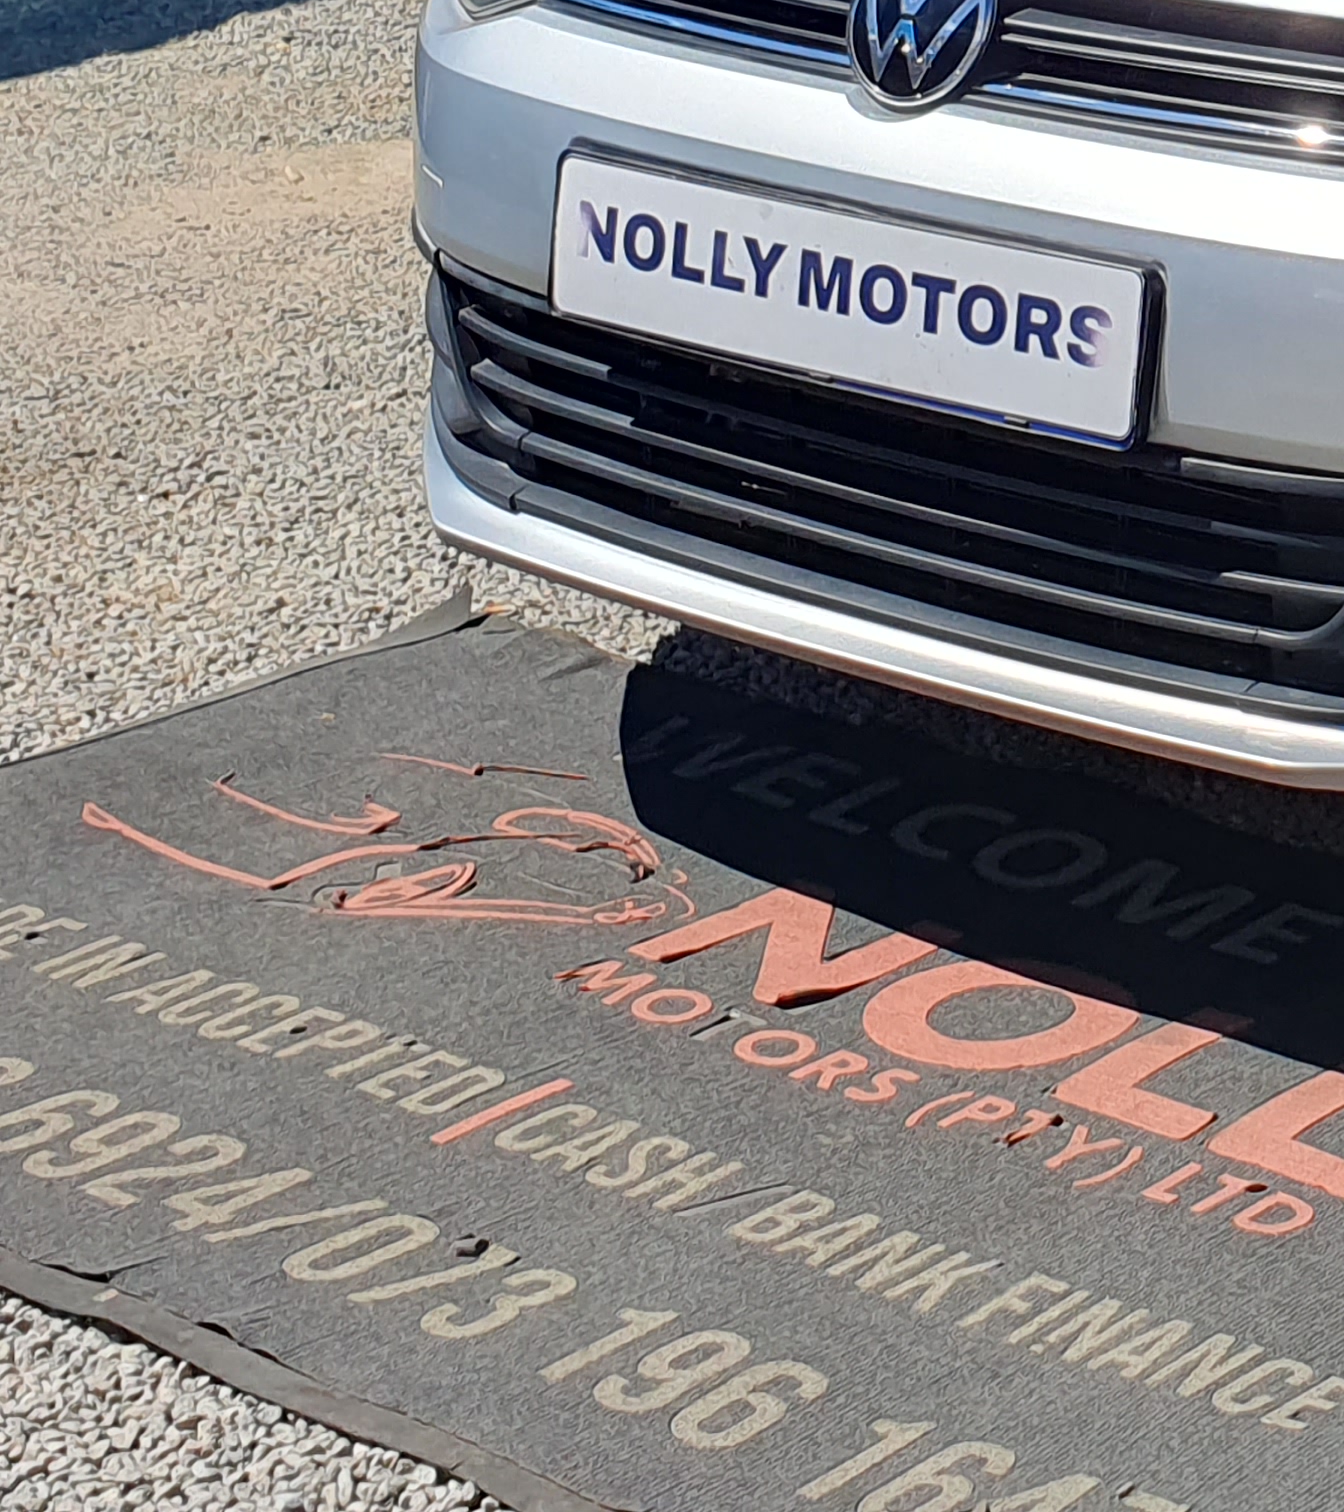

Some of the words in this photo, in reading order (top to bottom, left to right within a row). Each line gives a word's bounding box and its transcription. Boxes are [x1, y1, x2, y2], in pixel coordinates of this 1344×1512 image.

[577, 200, 787, 298] NOLLY
[797, 249, 1113, 368] MOTORS
[31, 934, 168, 989] IN
[553, 959, 920, 1103] MOTORS
[905, 1090, 1145, 1189] (PTY)
[1141, 1162, 1315, 1236] LTD
[538, 1306, 830, 1451] 196
